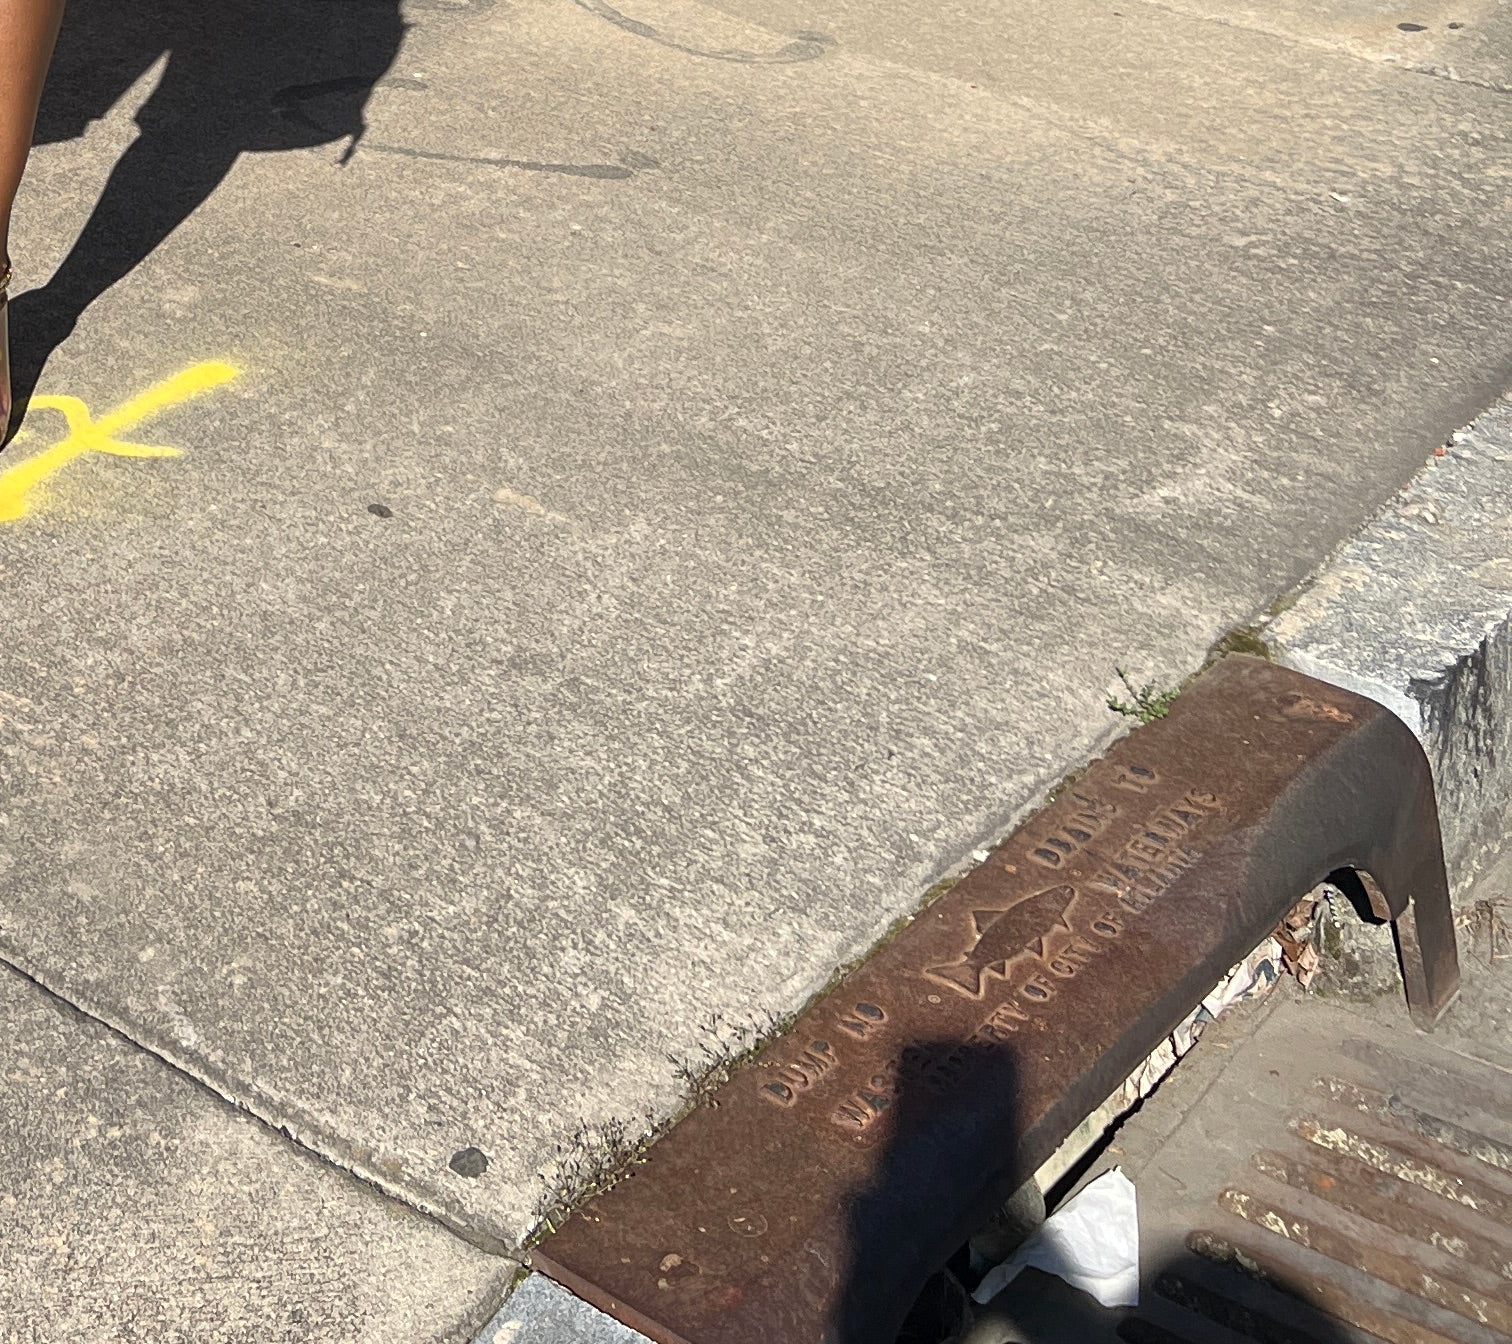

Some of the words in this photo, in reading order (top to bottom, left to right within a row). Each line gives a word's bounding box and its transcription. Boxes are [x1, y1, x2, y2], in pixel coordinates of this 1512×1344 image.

[1110, 764, 1159, 795] TO
[1021, 972, 1057, 1003] OF
[1048, 935, 1103, 978] CITY
[1091, 911, 1125, 938] OF
[758, 1039, 837, 1108] DUMP
[838, 1001, 888, 1040] NO
